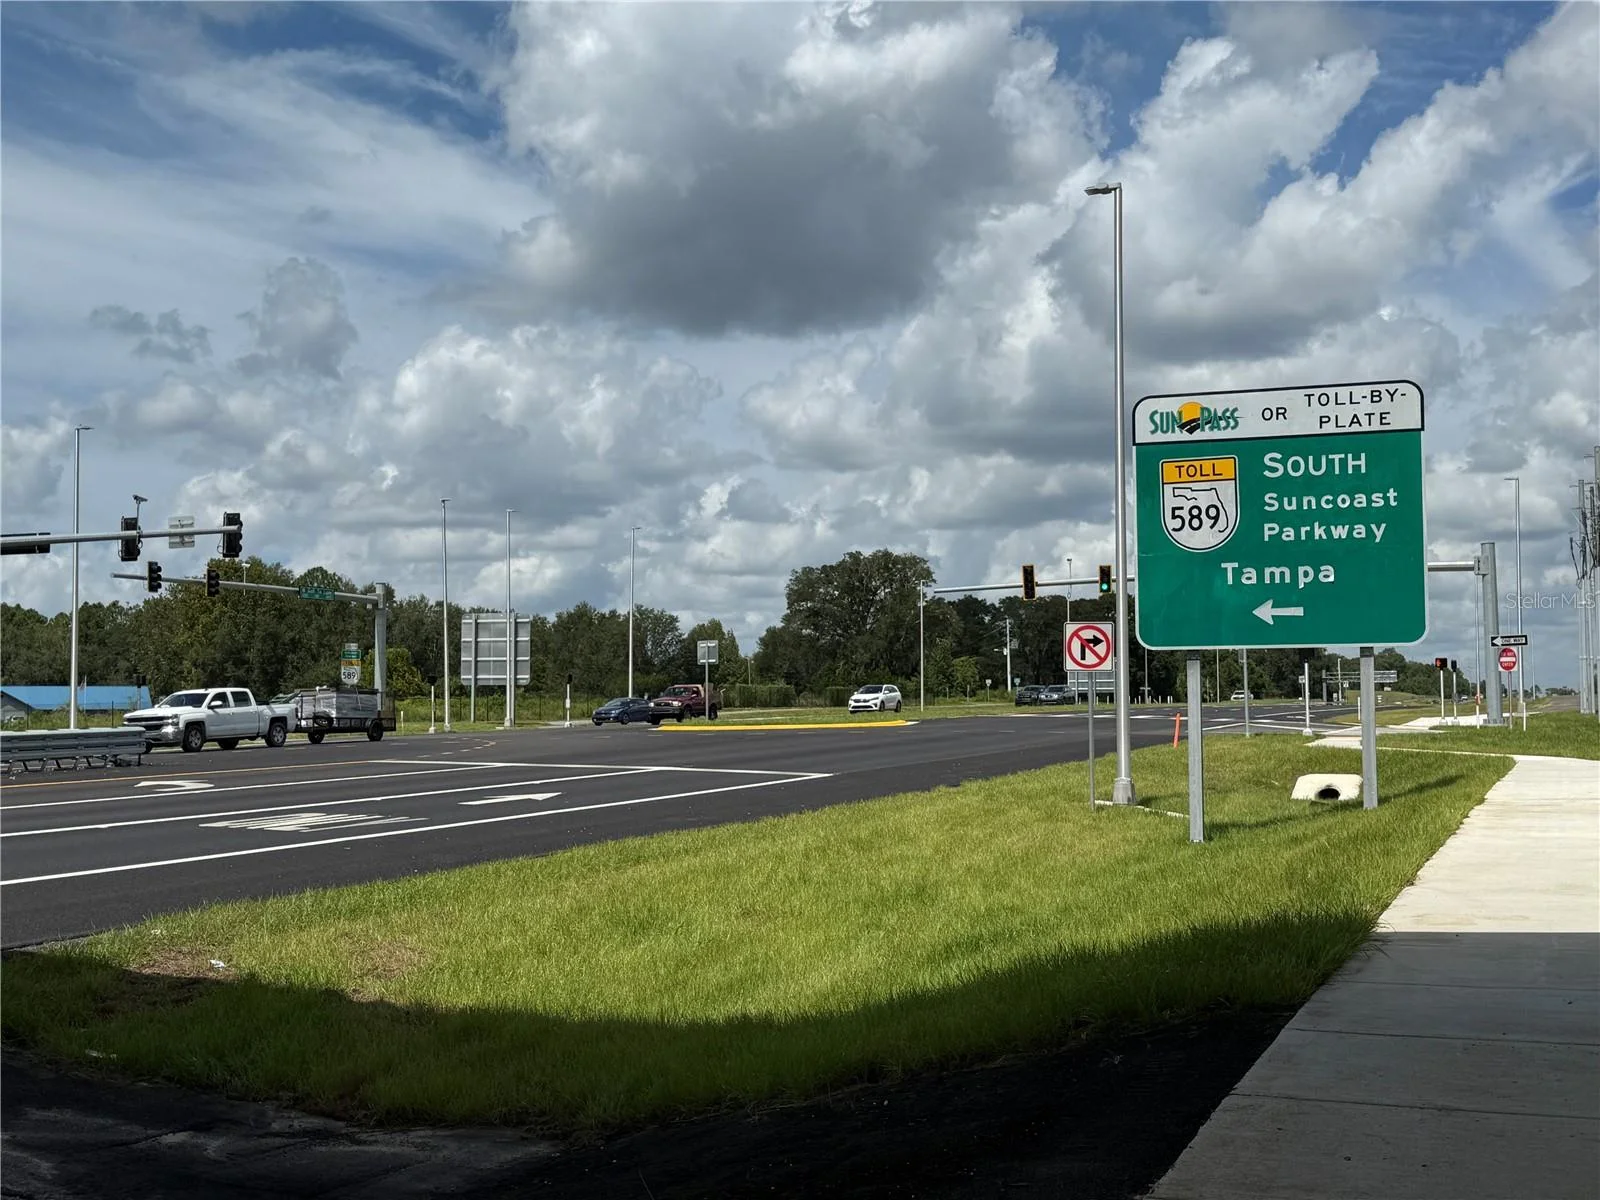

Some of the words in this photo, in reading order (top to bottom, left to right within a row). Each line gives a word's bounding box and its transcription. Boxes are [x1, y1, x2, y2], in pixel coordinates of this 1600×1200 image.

[1304, 388, 1406, 407] TOLL-BY-
[1261, 407, 1287, 421] OR
[1319, 411, 1391, 429] PLATE
[1175, 463, 1223, 478] TOLL
[1263, 488, 1398, 511] Suncoast
[1171, 504, 1220, 532] 589
[1263, 521, 1387, 543] Parkway
[1220, 562, 1335, 589] Tampa
[342, 672, 356, 680] 589
